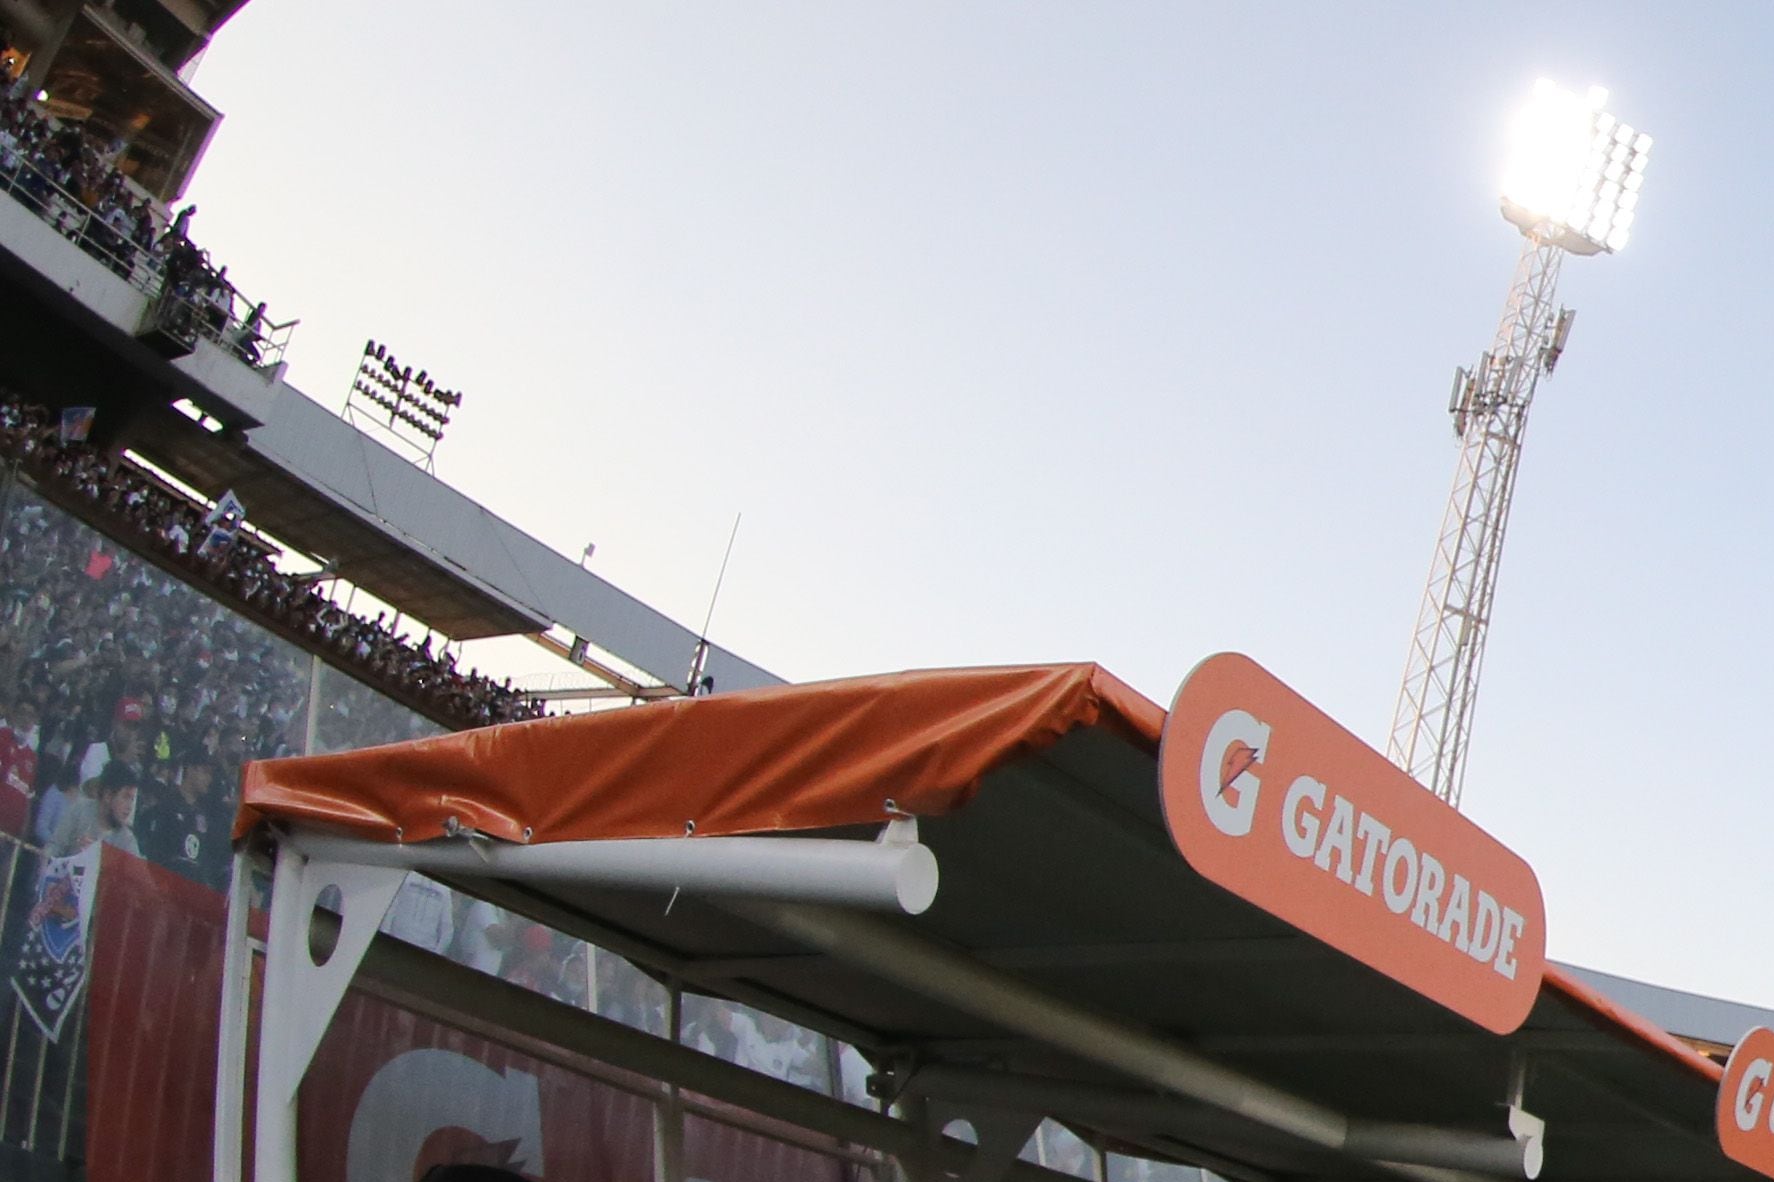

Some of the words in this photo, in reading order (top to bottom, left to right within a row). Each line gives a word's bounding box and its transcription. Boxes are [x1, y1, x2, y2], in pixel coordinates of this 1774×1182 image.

[1201, 709, 1272, 836] G
[1282, 775, 1525, 980] GATORADE
[1735, 1058, 1773, 1131] G
